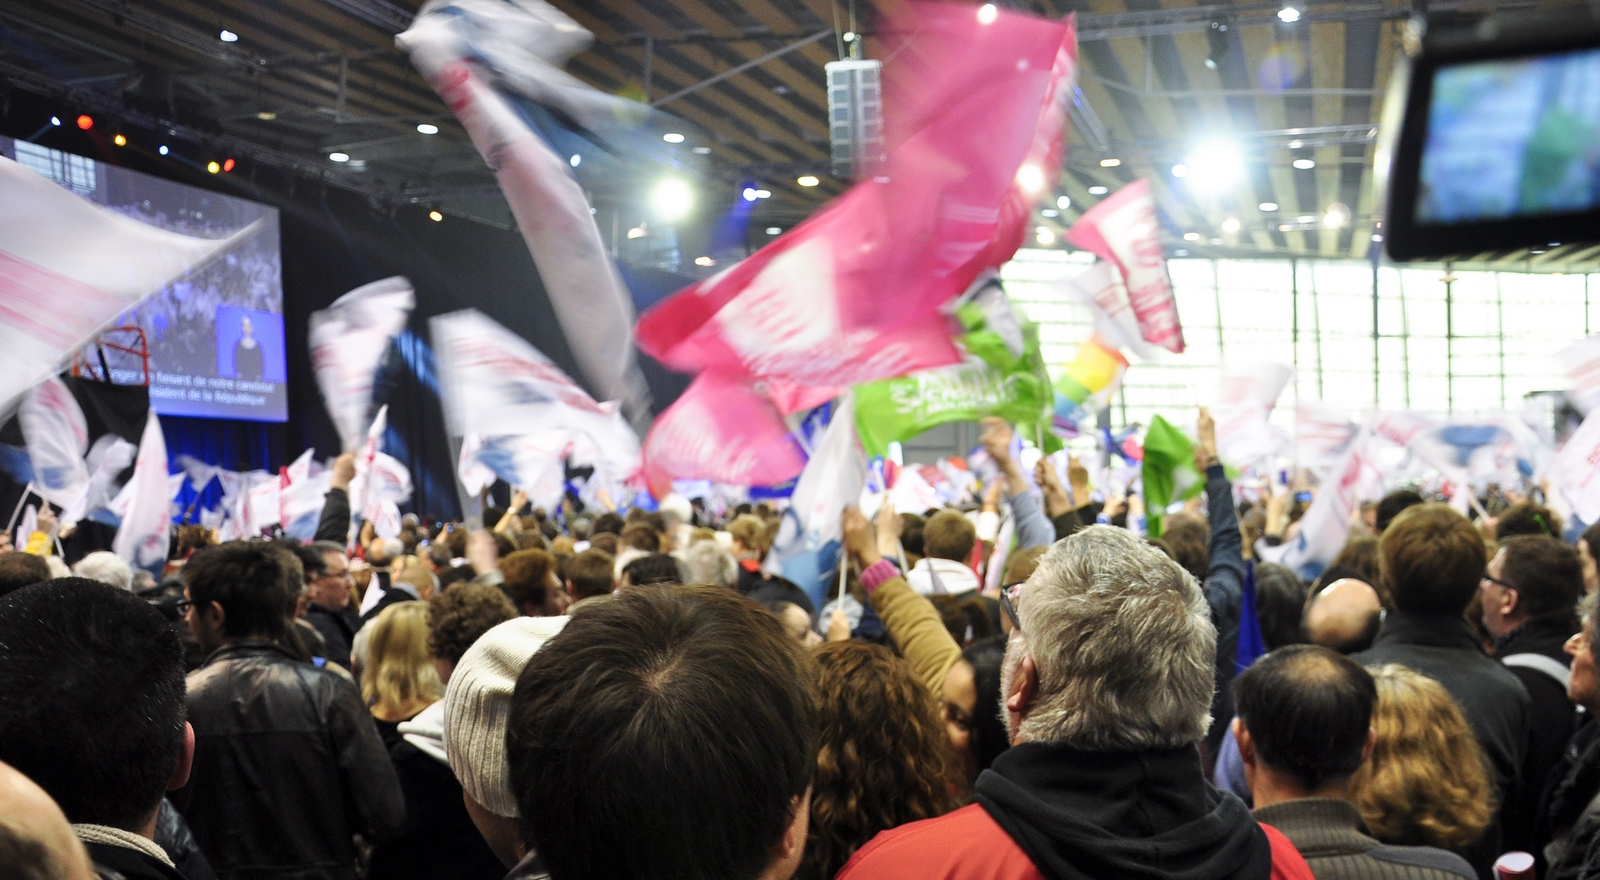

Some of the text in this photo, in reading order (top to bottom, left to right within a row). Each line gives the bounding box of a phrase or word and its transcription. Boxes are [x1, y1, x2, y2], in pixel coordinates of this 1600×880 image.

[157, 371, 192, 386] faisant
[192, 374, 207, 387] de
[208, 377, 235, 390] notre
[148, 385, 267, 406] ésident de la République
